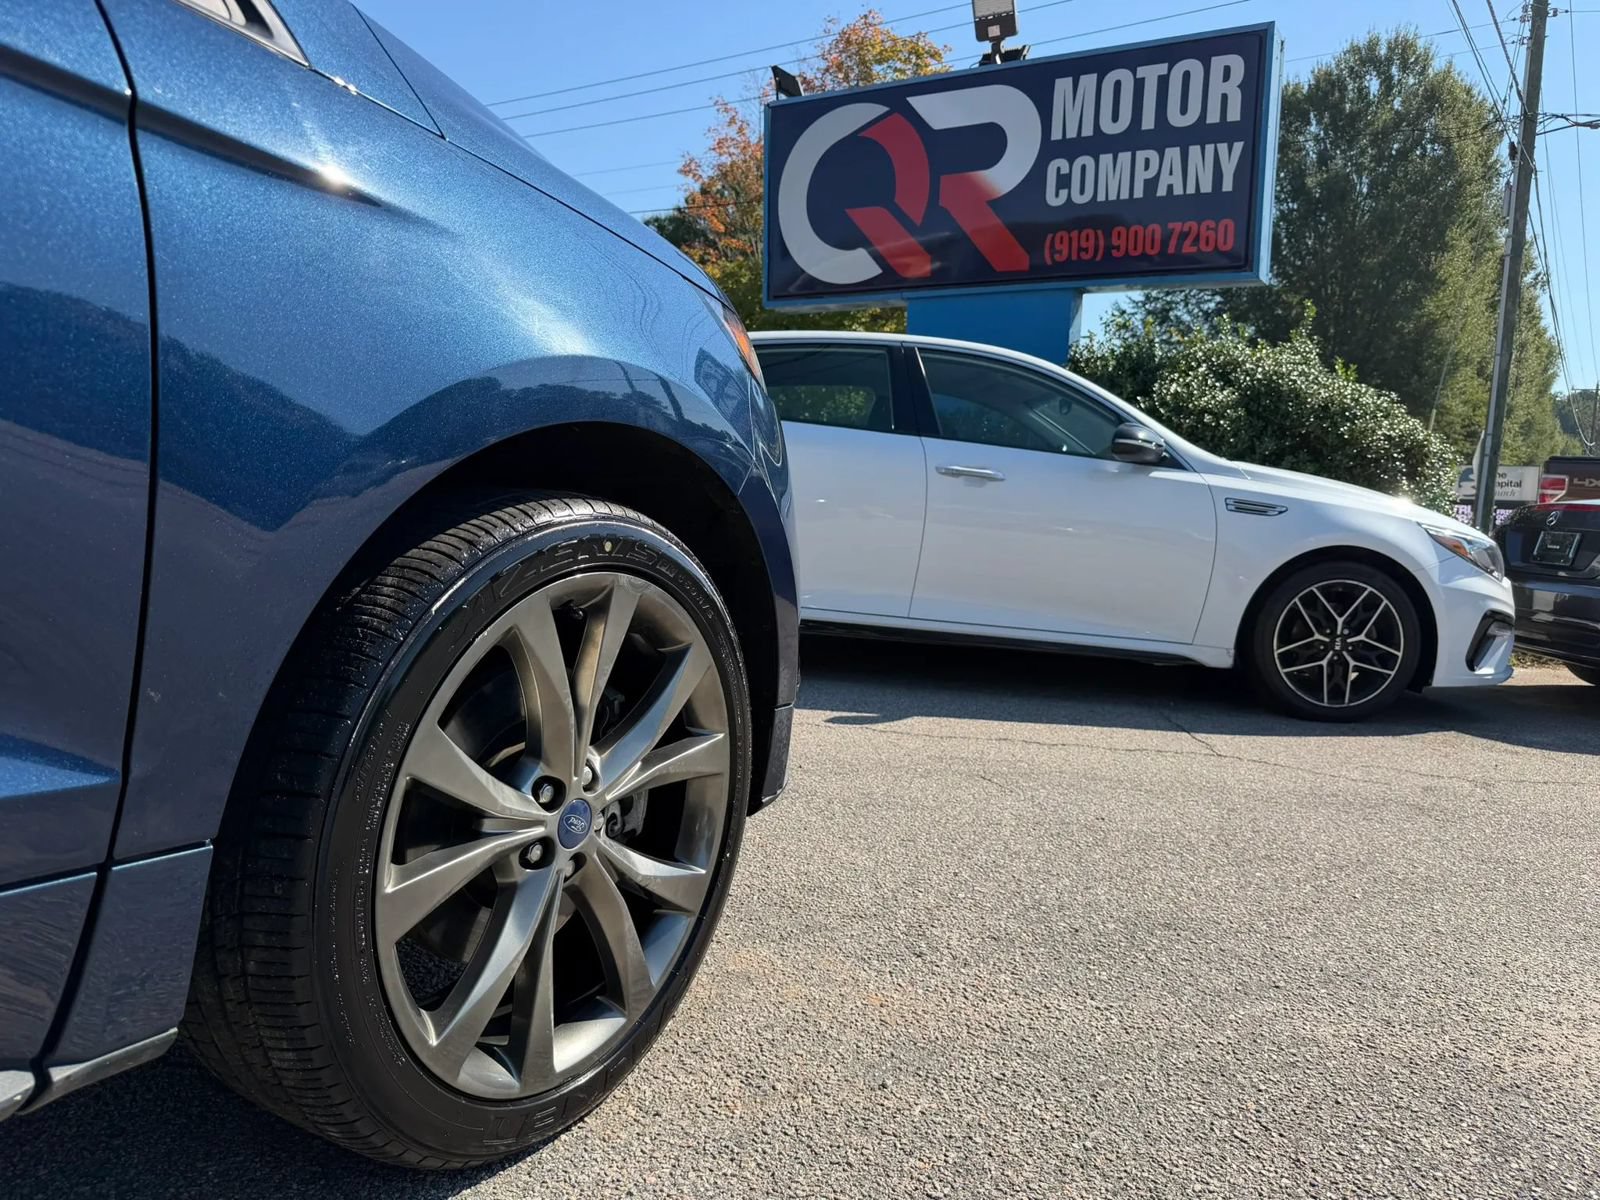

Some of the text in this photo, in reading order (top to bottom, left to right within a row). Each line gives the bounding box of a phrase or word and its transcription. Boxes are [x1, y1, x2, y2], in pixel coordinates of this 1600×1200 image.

[1051, 54, 1246, 140] MOTOR
[778, 84, 1042, 284] QR
[1045, 140, 1243, 207] COMPANY
[1044, 217, 1236, 266] (919) 900 7260
